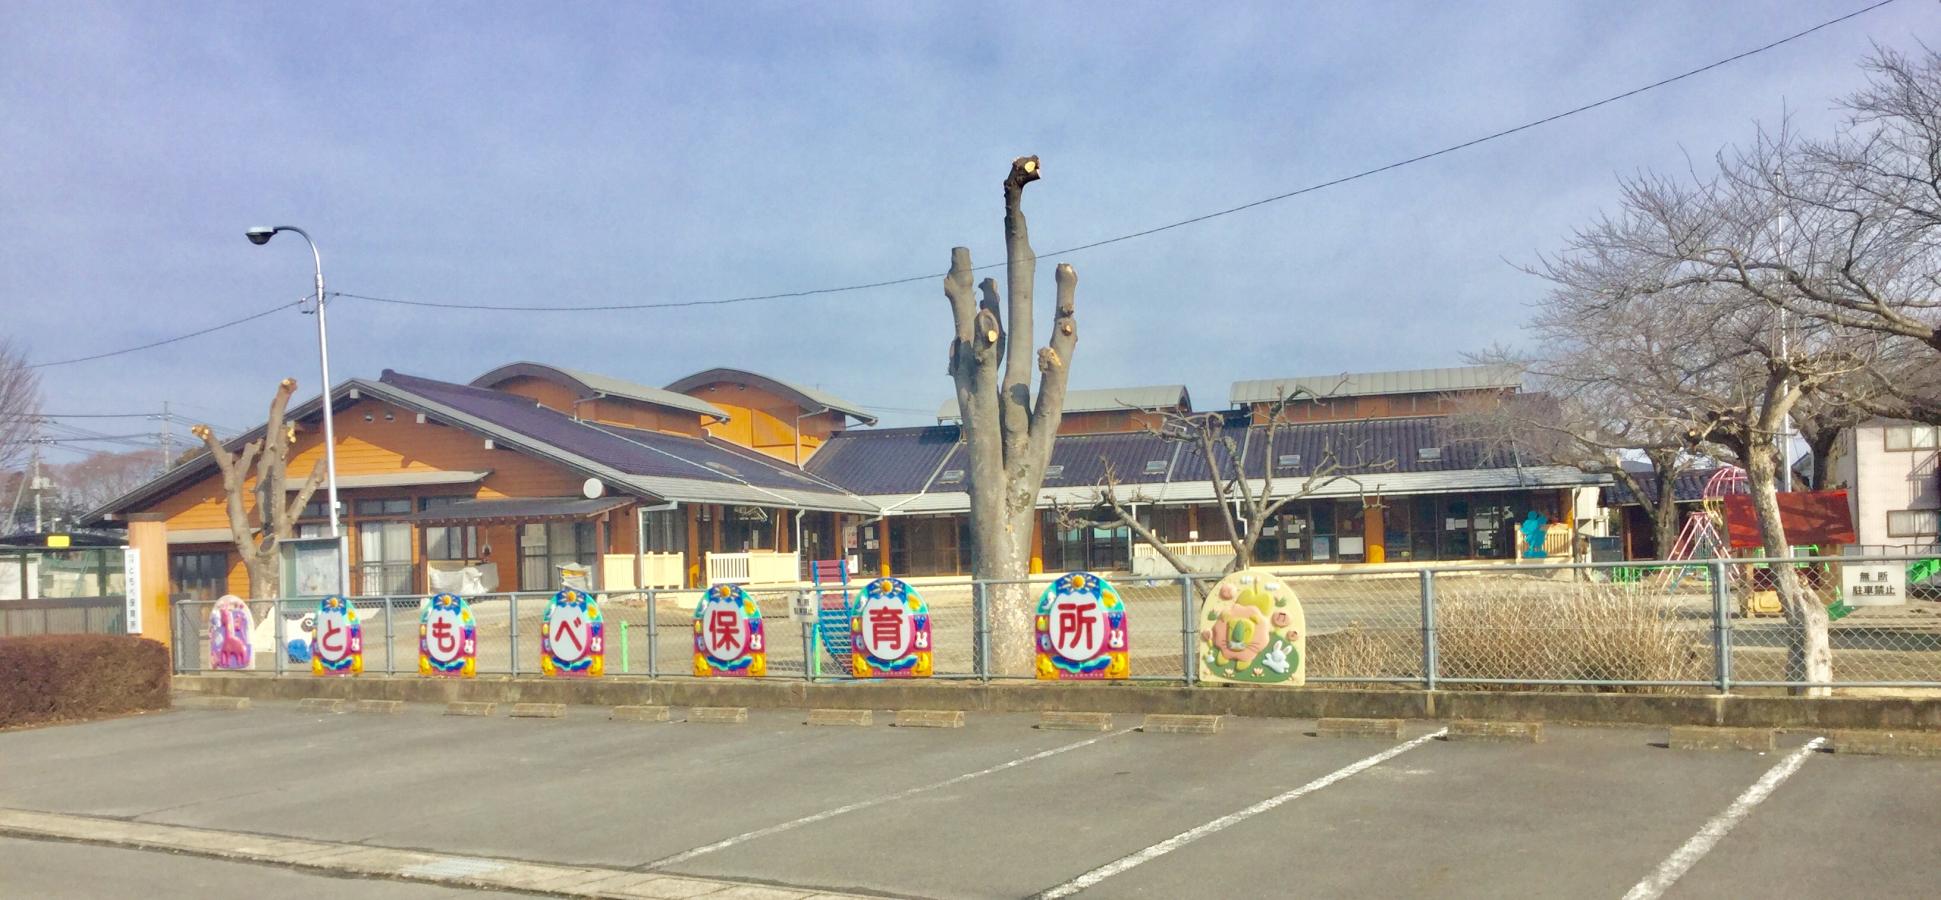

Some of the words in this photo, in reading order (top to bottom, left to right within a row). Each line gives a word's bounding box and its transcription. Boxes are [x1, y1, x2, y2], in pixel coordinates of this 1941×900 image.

[1853, 585, 1895, 596] 駐車禁止
[322, 619, 343, 652] と
[432, 616, 456, 653] も
[555, 616, 582, 651] べ
[709, 610, 740, 651] 保
[868, 606, 903, 650] 育
[1057, 603, 1097, 650] 所
